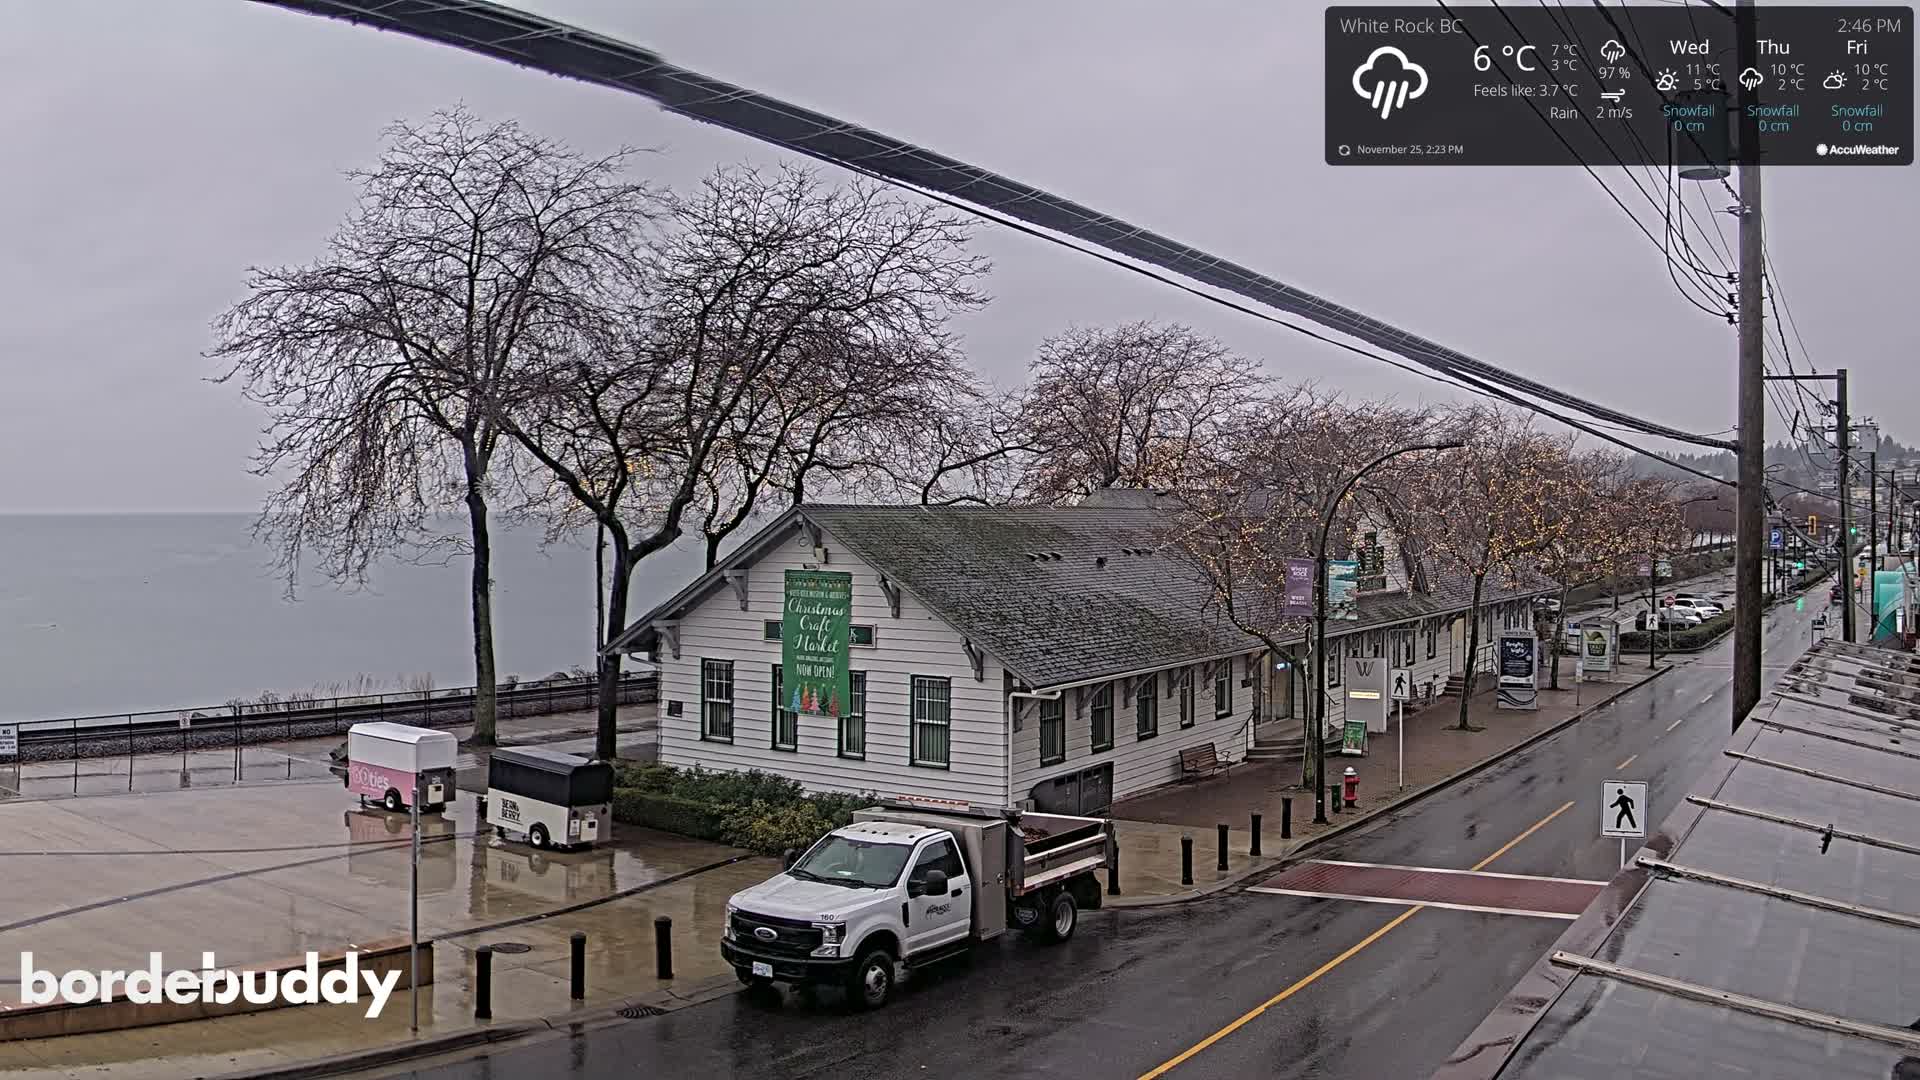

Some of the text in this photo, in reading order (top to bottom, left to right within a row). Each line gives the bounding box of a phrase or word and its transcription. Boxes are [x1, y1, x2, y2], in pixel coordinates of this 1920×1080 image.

[788, 597, 844, 617] Christmas
[800, 614, 832, 641] Craft
[793, 633, 840, 653] Market
[796, 663, 835, 679] NOW OPEN!
[501, 808, 521, 822] BERRY
